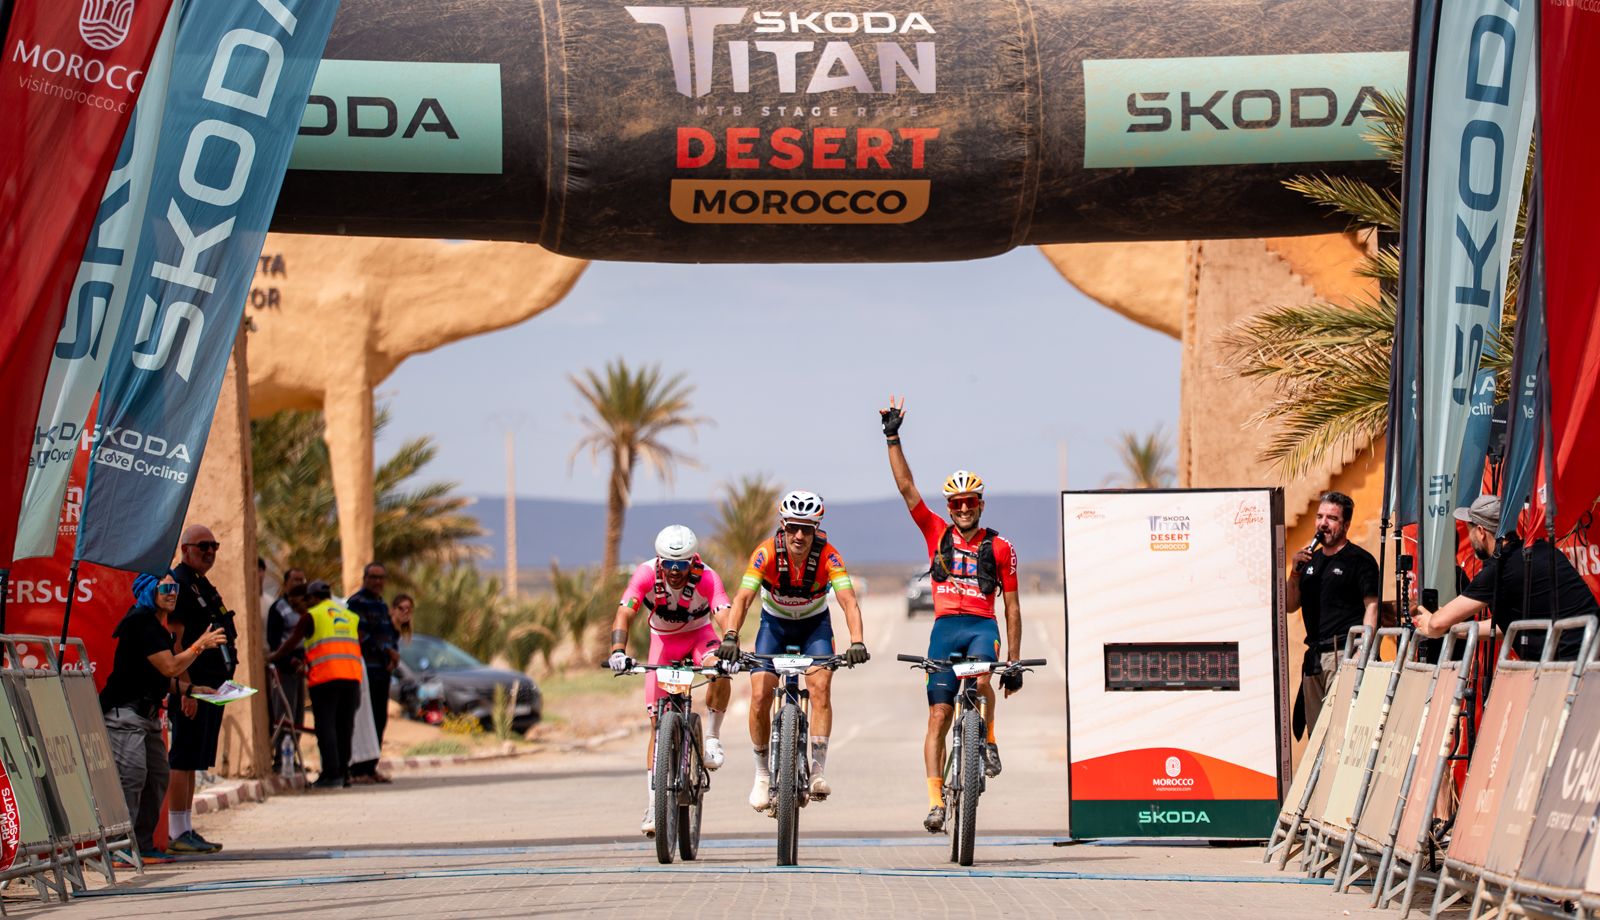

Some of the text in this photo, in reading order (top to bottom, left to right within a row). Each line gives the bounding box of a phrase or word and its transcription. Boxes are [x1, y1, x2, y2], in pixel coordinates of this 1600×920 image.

[624, 6, 936, 98] TITAN
[697, 106, 918, 117] MTB STAGE RACE
[676, 127, 941, 169] DESERT
[692, 189, 907, 215] MOROCCO
[134, 459, 189, 484] Cycling
[1151, 533, 1190, 541] DESERT
[1152, 778, 1195, 786] MOROCCO
